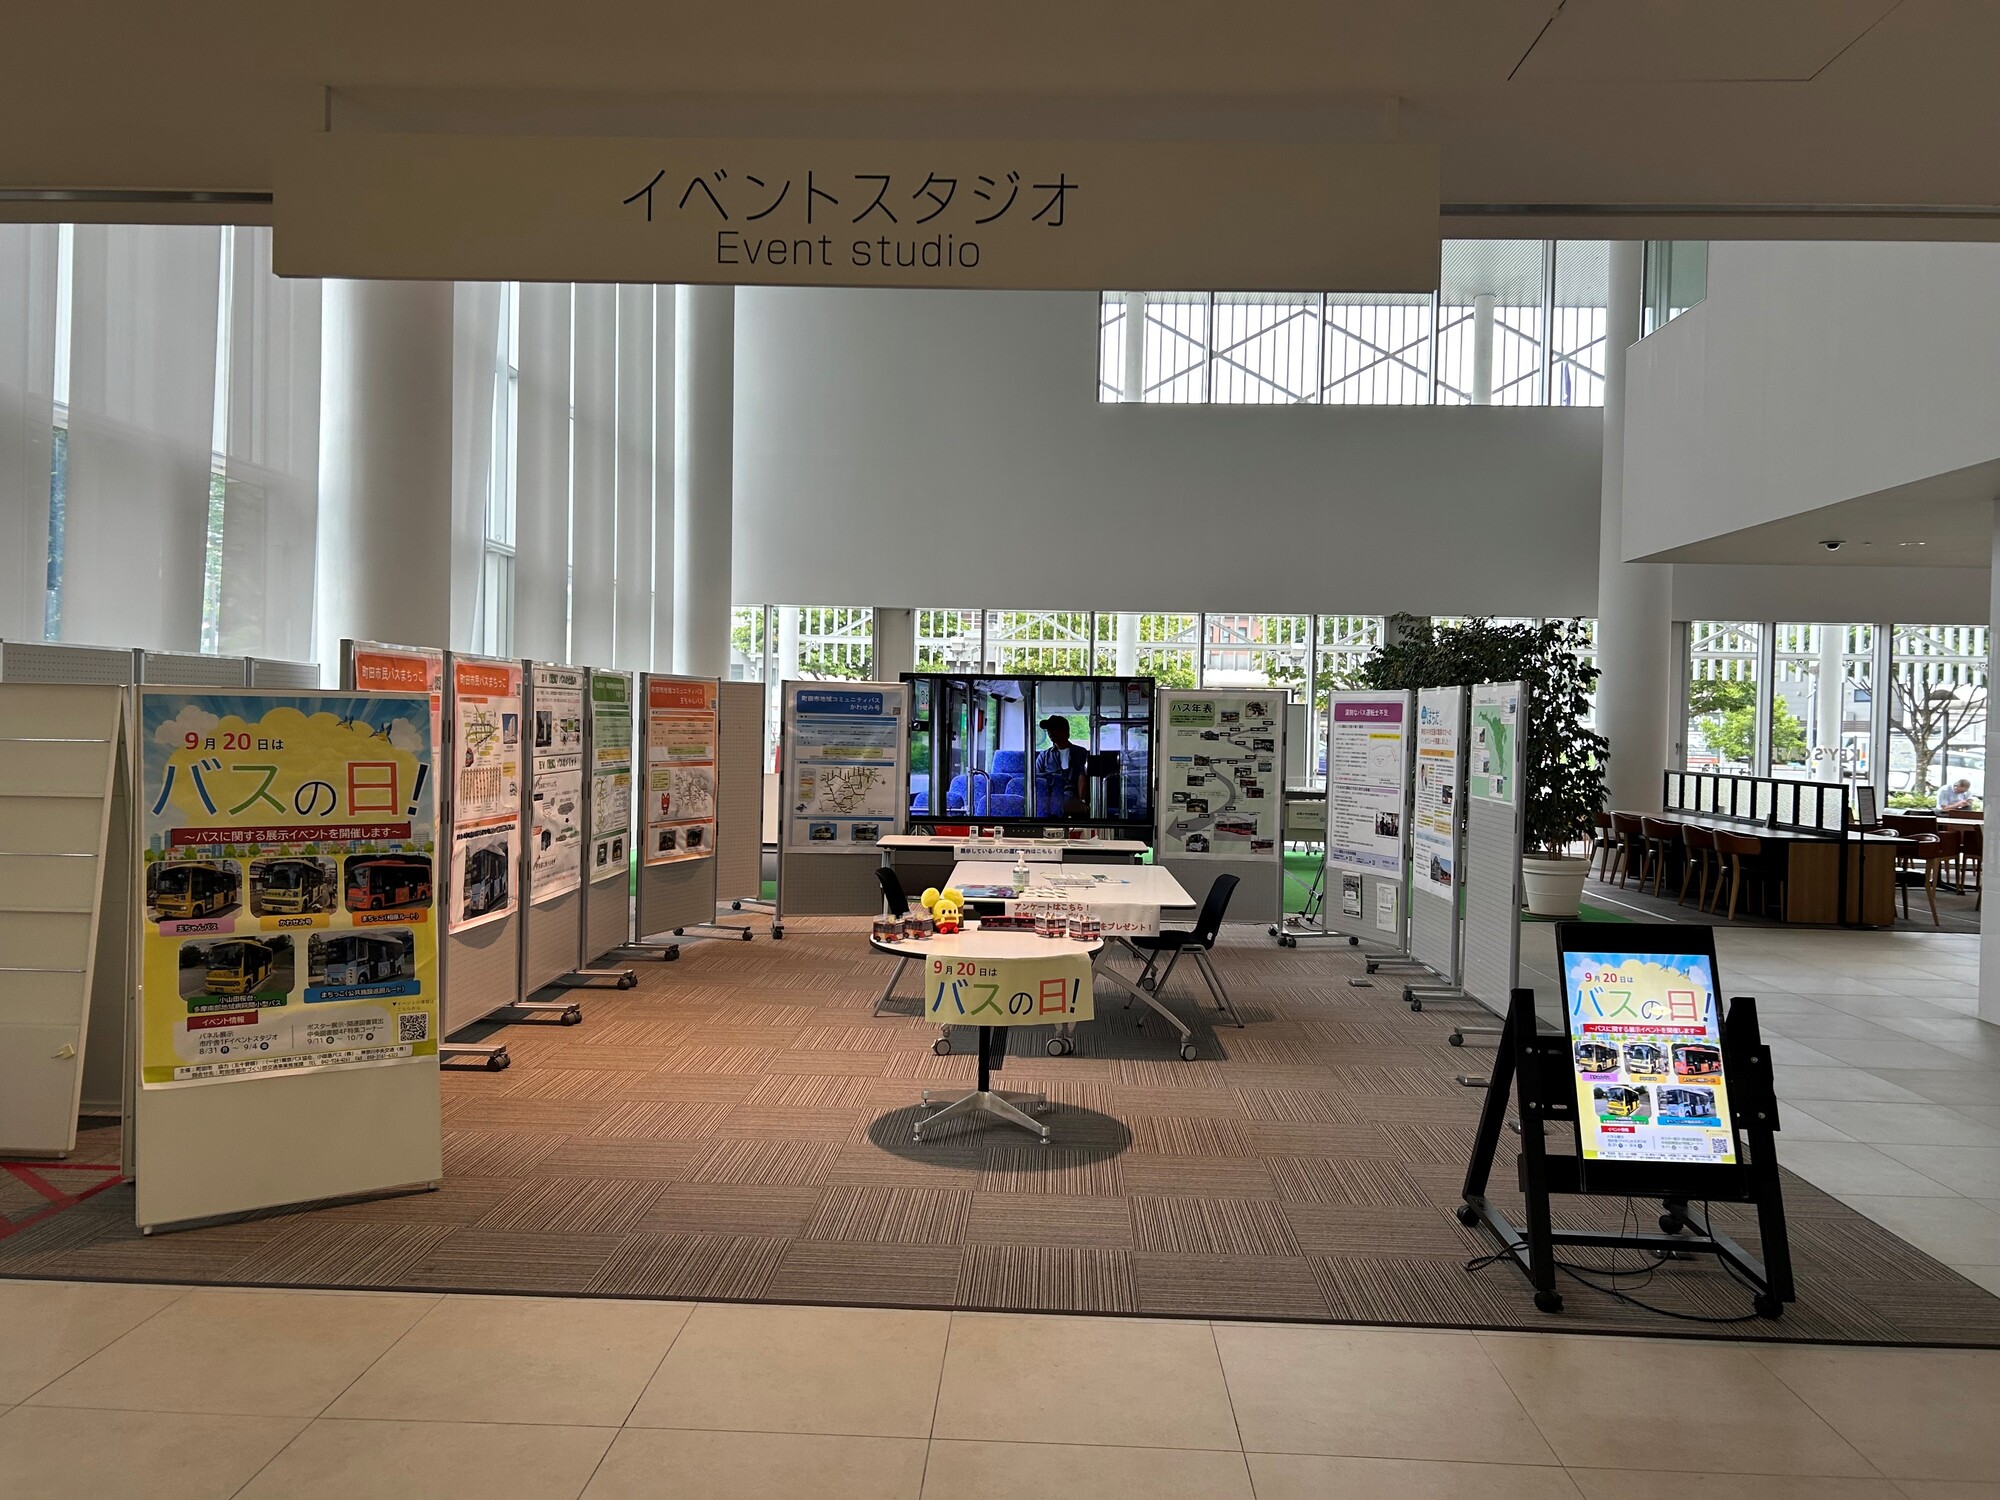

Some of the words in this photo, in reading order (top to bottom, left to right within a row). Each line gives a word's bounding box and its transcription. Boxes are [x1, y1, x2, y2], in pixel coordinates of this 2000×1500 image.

[622, 167, 1080, 227] イベントスタジオ
[716, 231, 833, 266] Event
[851, 233, 981, 268] studio
[361, 665, 424, 682] 町田市民バスまちっこ
[459, 673, 507, 688] 町田市民バスまちっこ
[849, 704, 881, 712] かわせみ号
[184, 732, 284, 751] 9月20日は
[152, 757, 430, 818] バスの日!
[1014, 902, 1090, 911] アンケートはこちら！
[176, 923, 219, 933] 玉ちゃんバス
[278, 917, 313, 928] かわせみ号
[933, 959, 998, 978] 9月20日は
[1584, 972, 1634, 984] 9月20日は
[931, 977, 1081, 1016] バスの日!
[1573, 986, 1712, 1023] バスの日!
[201, 1015, 246, 1026] イベント情報
[199, 1030, 234, 1040] パネル展示
[307, 1037, 324, 1045] 9/11
[199, 1047, 218, 1055] 8/31
[243, 1043, 258, 1051] 9/4
